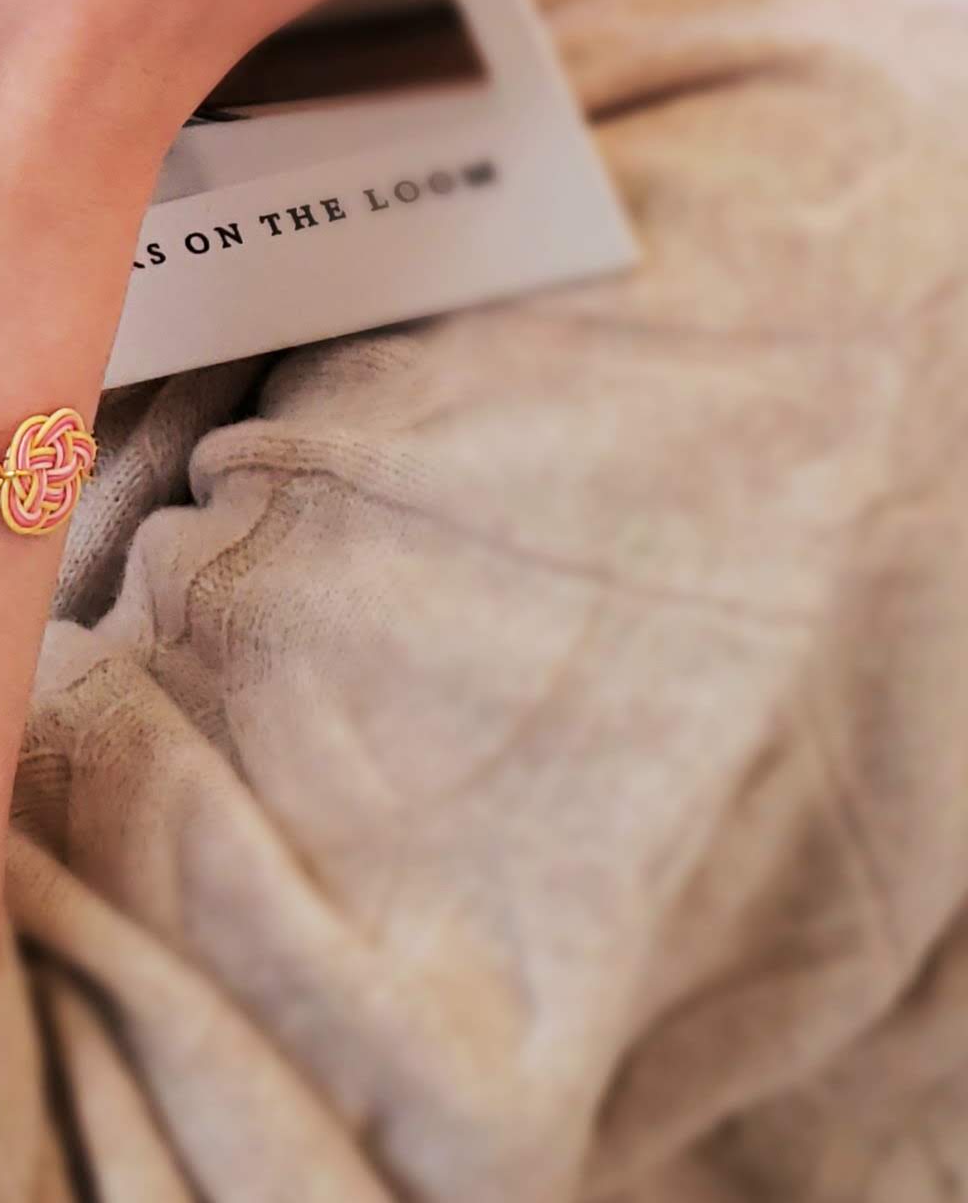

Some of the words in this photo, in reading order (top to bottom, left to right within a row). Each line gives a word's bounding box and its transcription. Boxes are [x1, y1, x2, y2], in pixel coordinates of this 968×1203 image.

[133, 243, 166, 270] S
[184, 223, 244, 255] ON
[259, 198, 347, 237] THE
